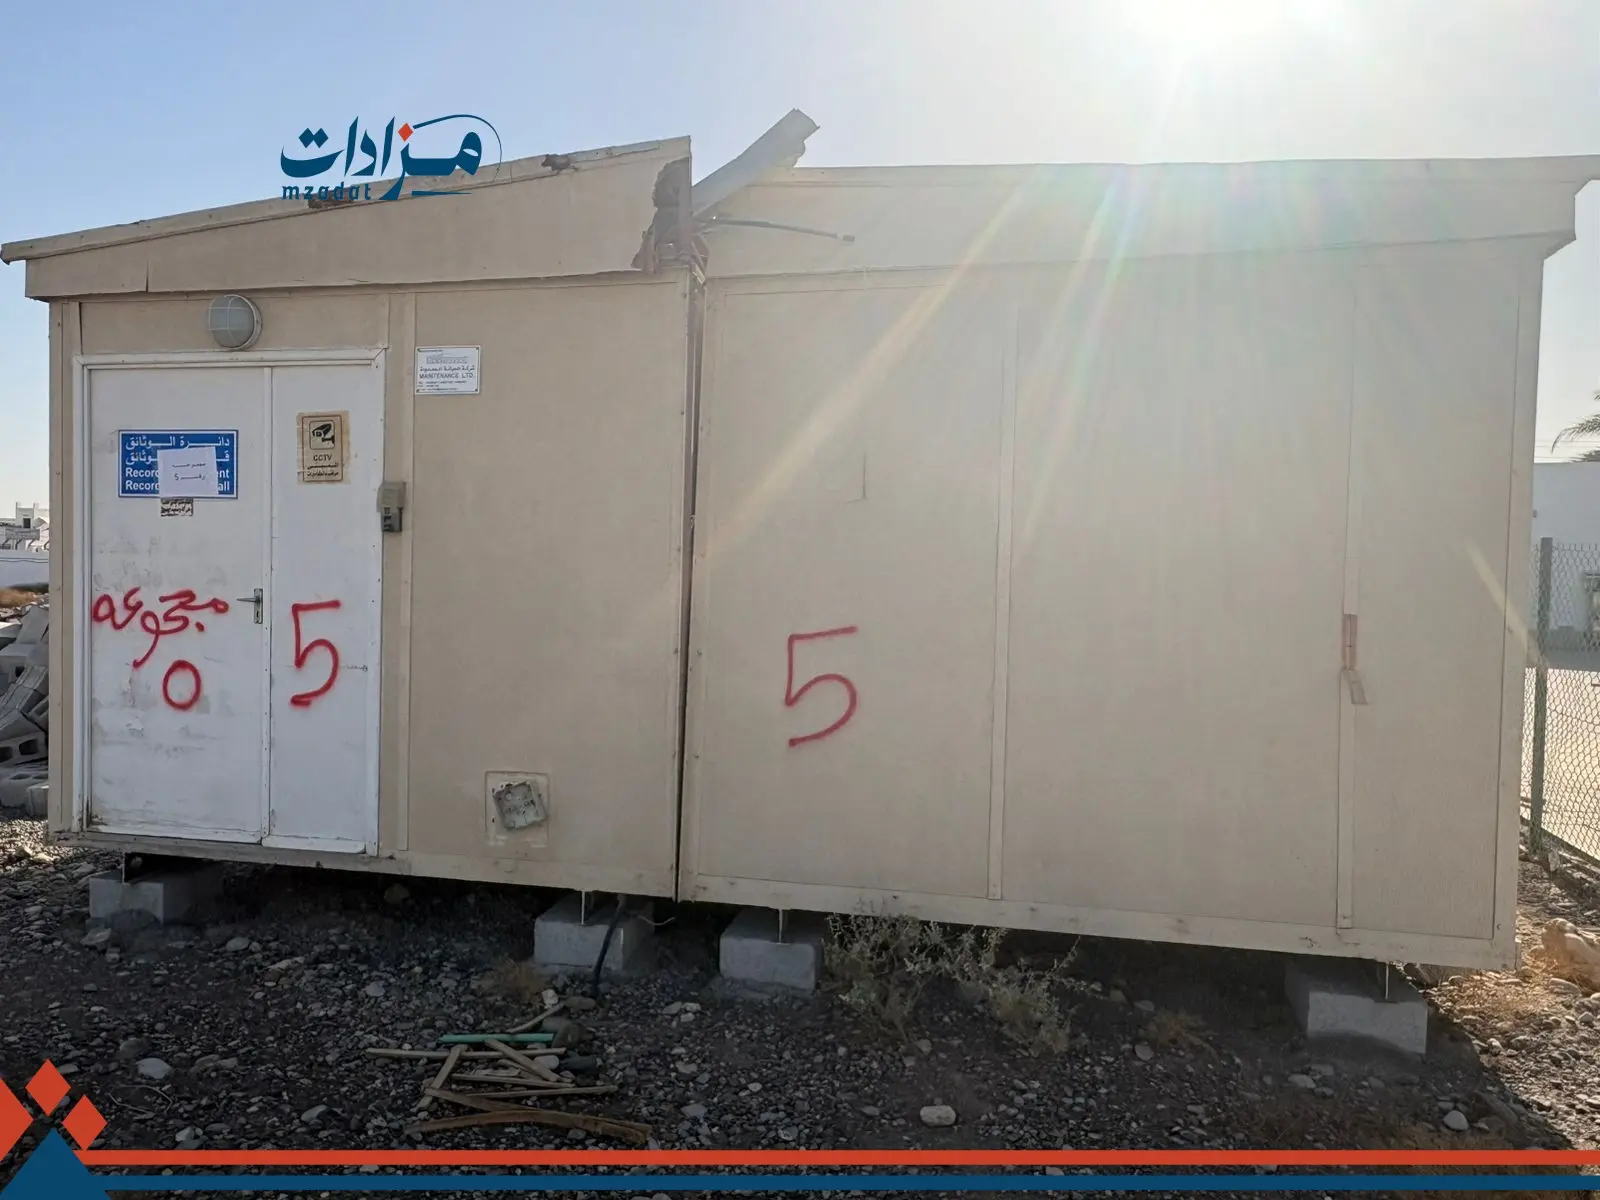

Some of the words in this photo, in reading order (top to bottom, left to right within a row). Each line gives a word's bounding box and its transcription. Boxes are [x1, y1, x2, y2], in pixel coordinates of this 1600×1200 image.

[125, 435, 176, 450] الوثائق
[180, 435, 230, 449] دائرة
[289, 599, 342, 707] 5
[785, 626, 858, 747] 5
